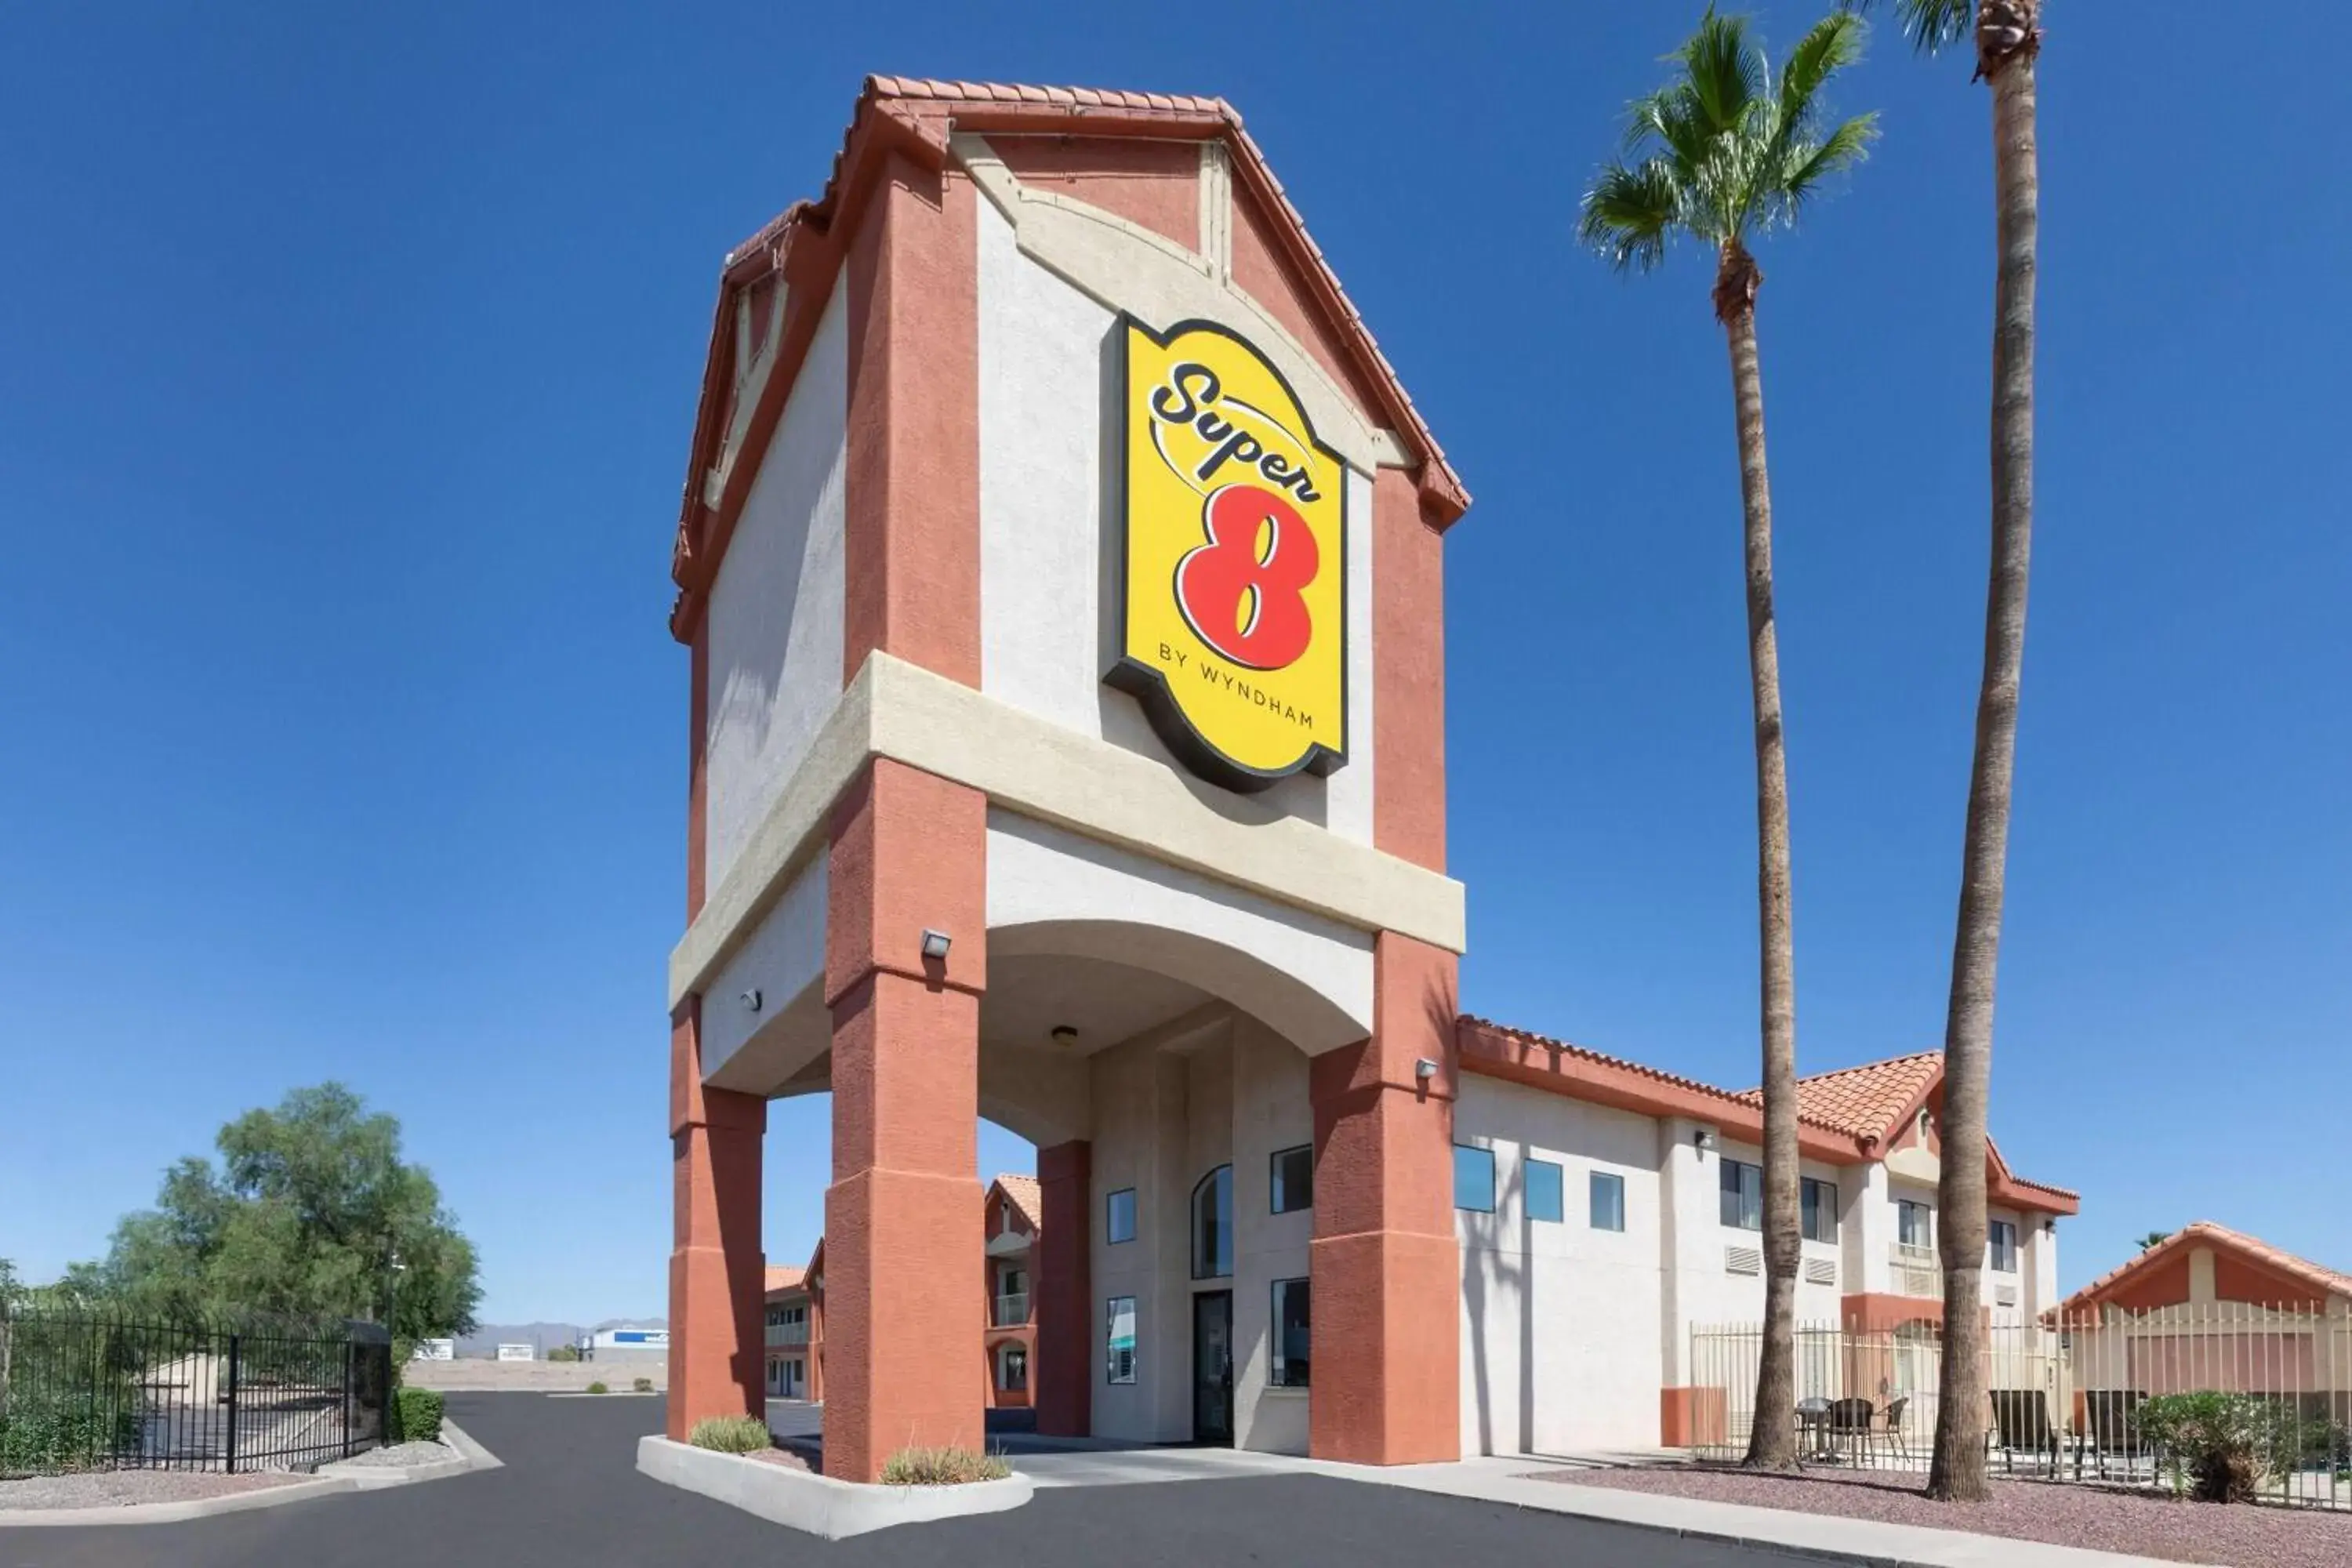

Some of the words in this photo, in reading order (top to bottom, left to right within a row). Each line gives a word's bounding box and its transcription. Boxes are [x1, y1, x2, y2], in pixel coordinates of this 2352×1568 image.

[1150, 362, 1321, 503] Super
[1173, 483, 1319, 671] 8
[1159, 642, 1188, 668] BY
[1200, 662, 1312, 729] WYNDHAM
